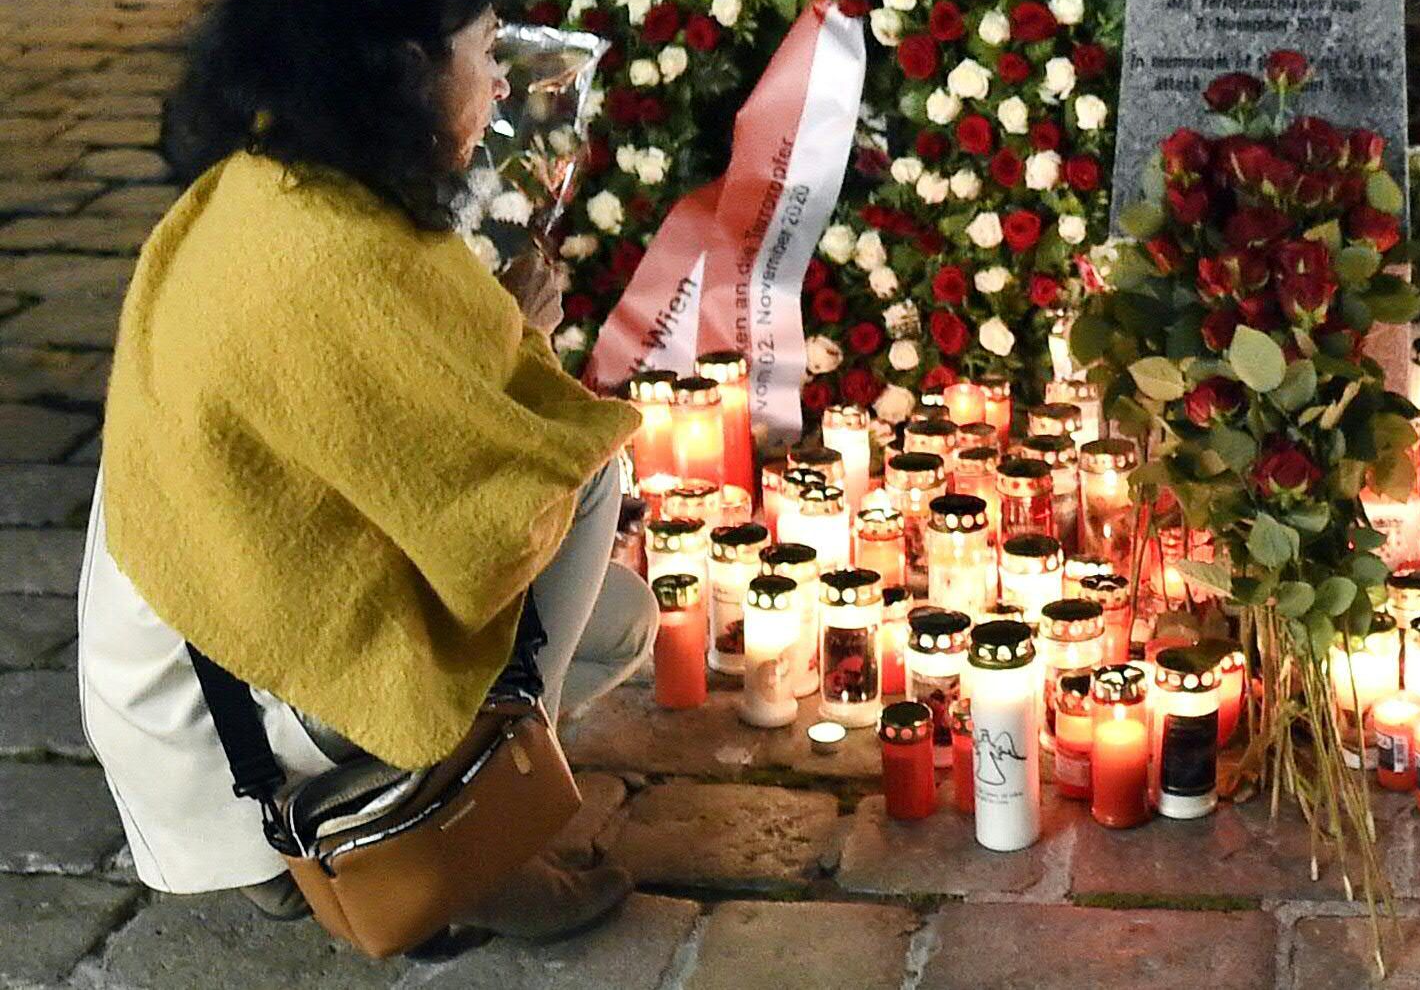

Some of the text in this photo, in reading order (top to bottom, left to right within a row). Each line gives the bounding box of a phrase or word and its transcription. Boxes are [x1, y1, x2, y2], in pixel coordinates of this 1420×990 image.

[756, 229, 794, 326] November
[780, 184, 810, 226] 2020
[641, 277, 698, 350] Wien
